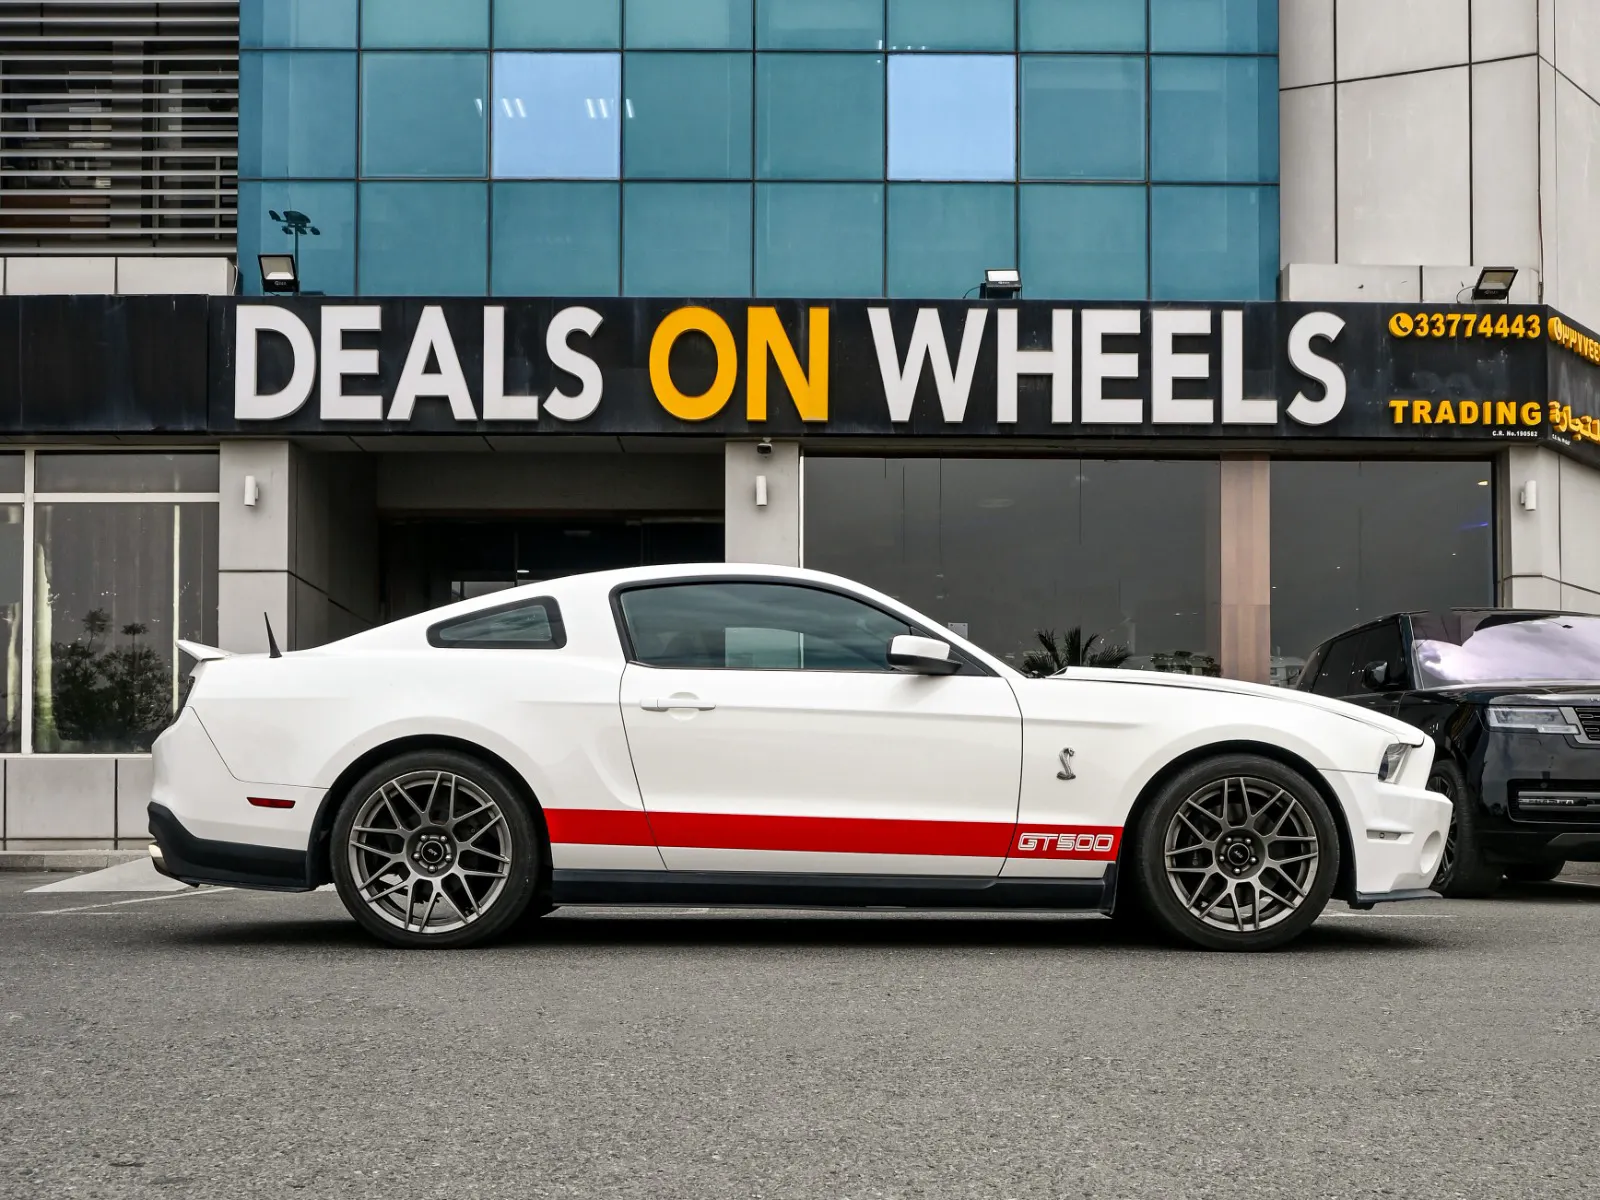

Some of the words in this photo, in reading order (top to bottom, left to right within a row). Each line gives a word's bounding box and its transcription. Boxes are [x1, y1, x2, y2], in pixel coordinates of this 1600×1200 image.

[1414, 313, 1541, 338] 33774443
[234, 305, 604, 421] DEALS
[649, 305, 830, 421] ON
[867, 307, 1348, 426] WHEELS
[1389, 400, 1542, 425] TRADING
[1018, 832, 1114, 852] GT500
